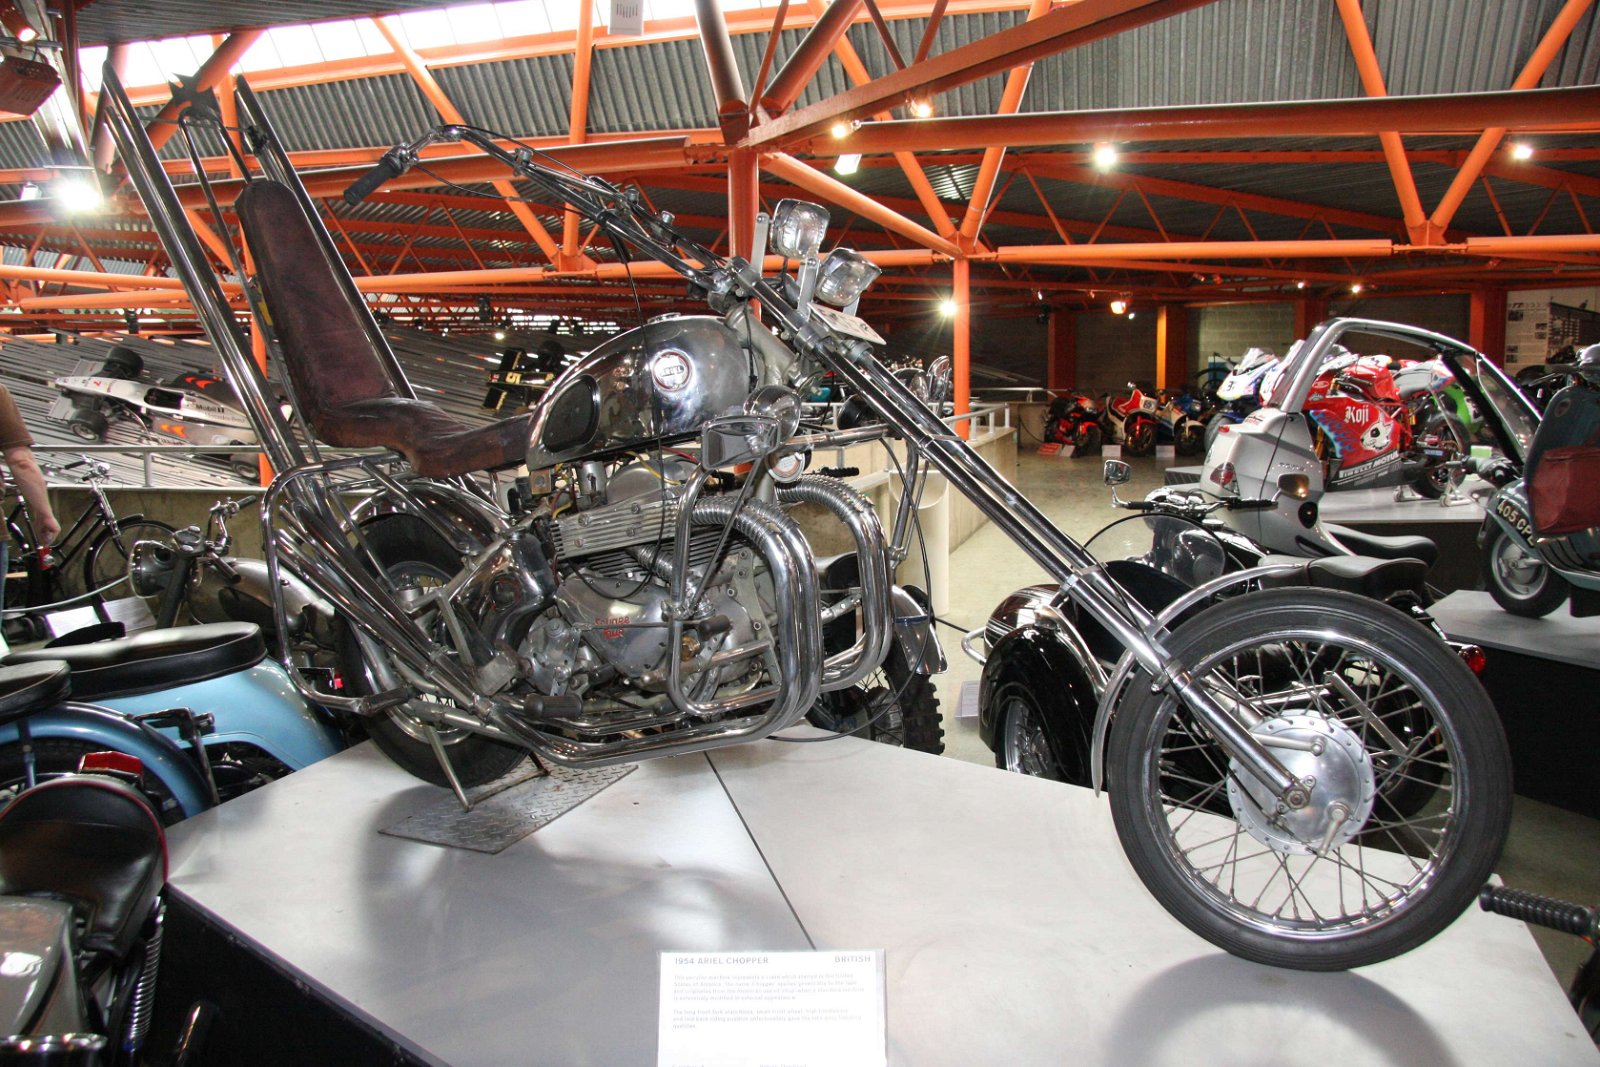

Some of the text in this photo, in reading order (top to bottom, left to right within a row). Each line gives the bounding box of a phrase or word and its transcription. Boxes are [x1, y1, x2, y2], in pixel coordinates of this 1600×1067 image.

[1344, 404, 1369, 426] Koji
[1373, 450, 1400, 468] MOTUL
[1497, 499, 1519, 523] 405
[675, 955, 769, 965] 1954 ARIEL CHOPPER
[834, 954, 871, 963] BRITISH
